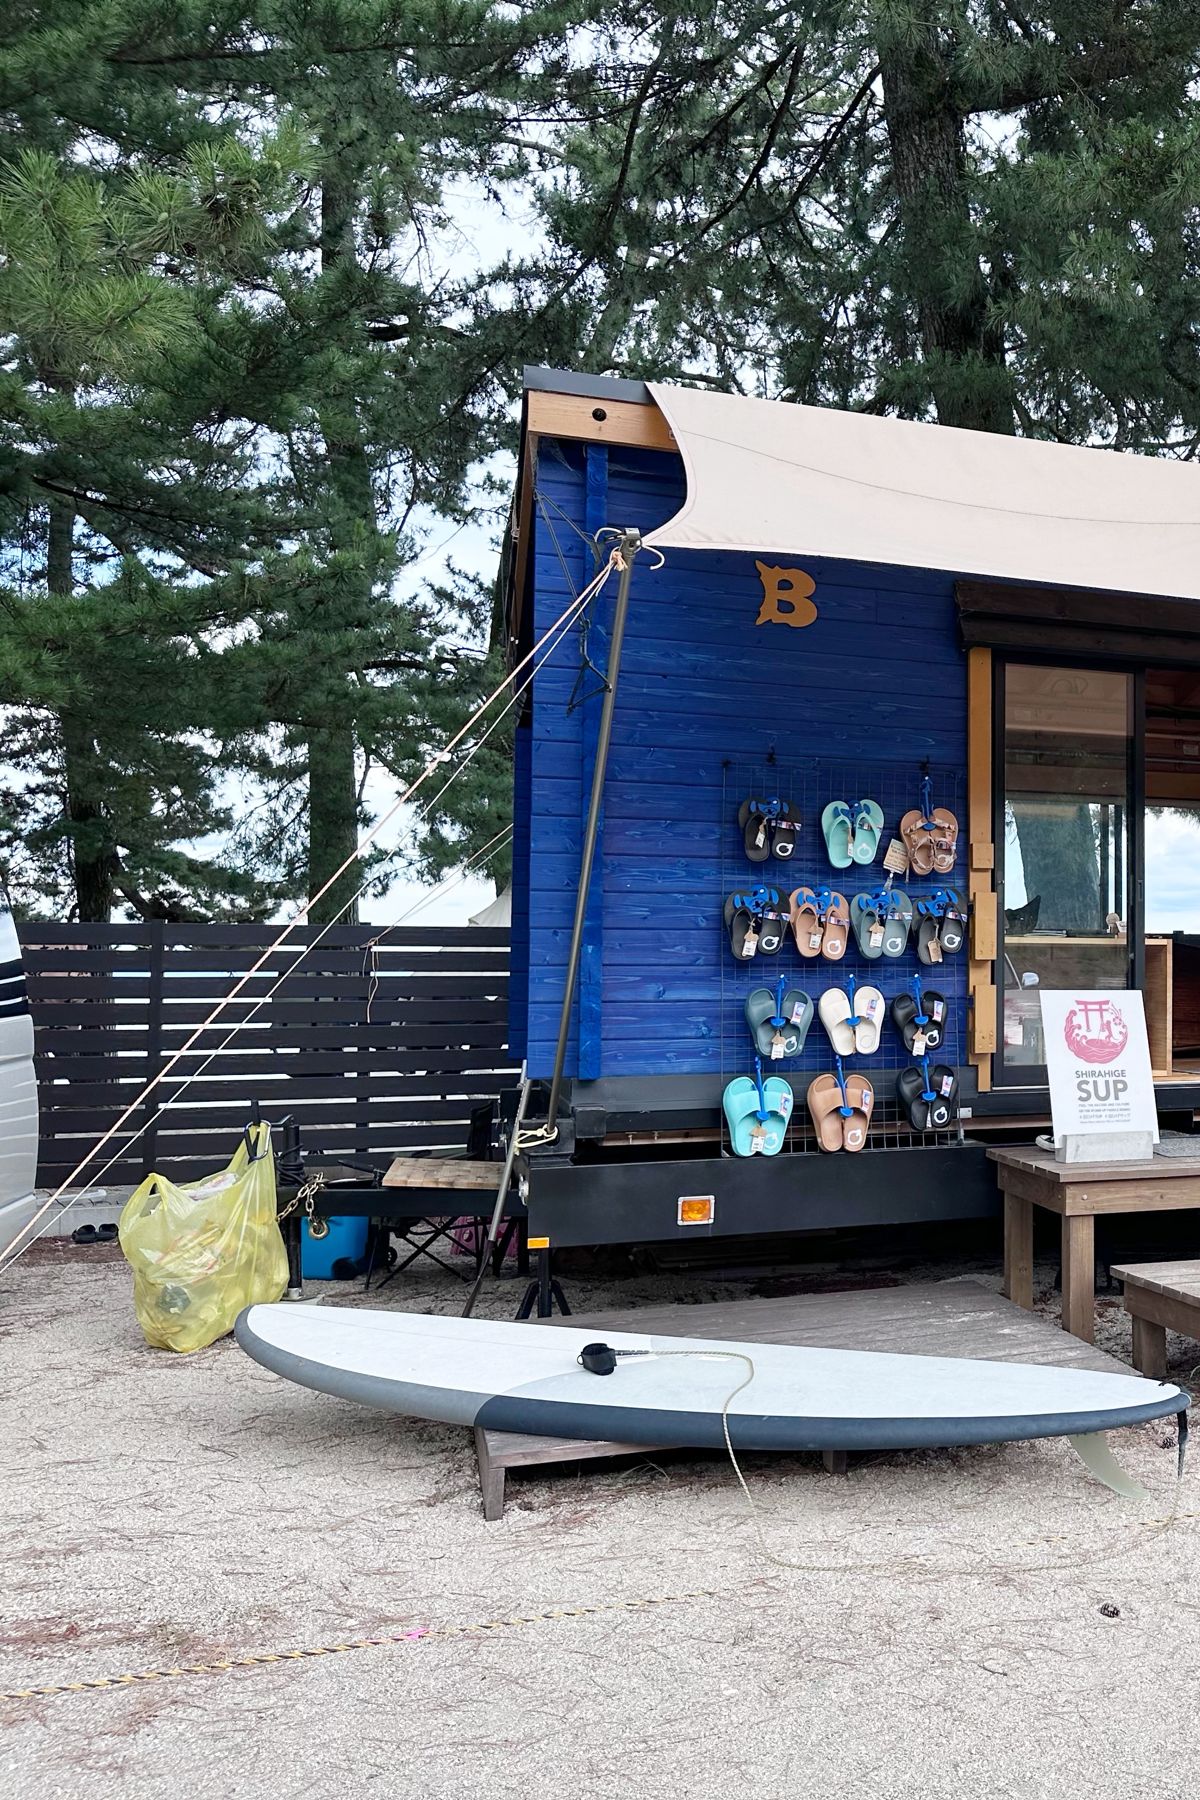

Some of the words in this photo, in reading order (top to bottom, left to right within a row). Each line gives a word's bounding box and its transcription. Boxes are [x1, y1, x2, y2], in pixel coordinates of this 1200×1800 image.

[755, 559, 818, 628] B
[1075, 1070, 1126, 1078] SHIRAHIGE
[1077, 1080, 1128, 1102] SUP
